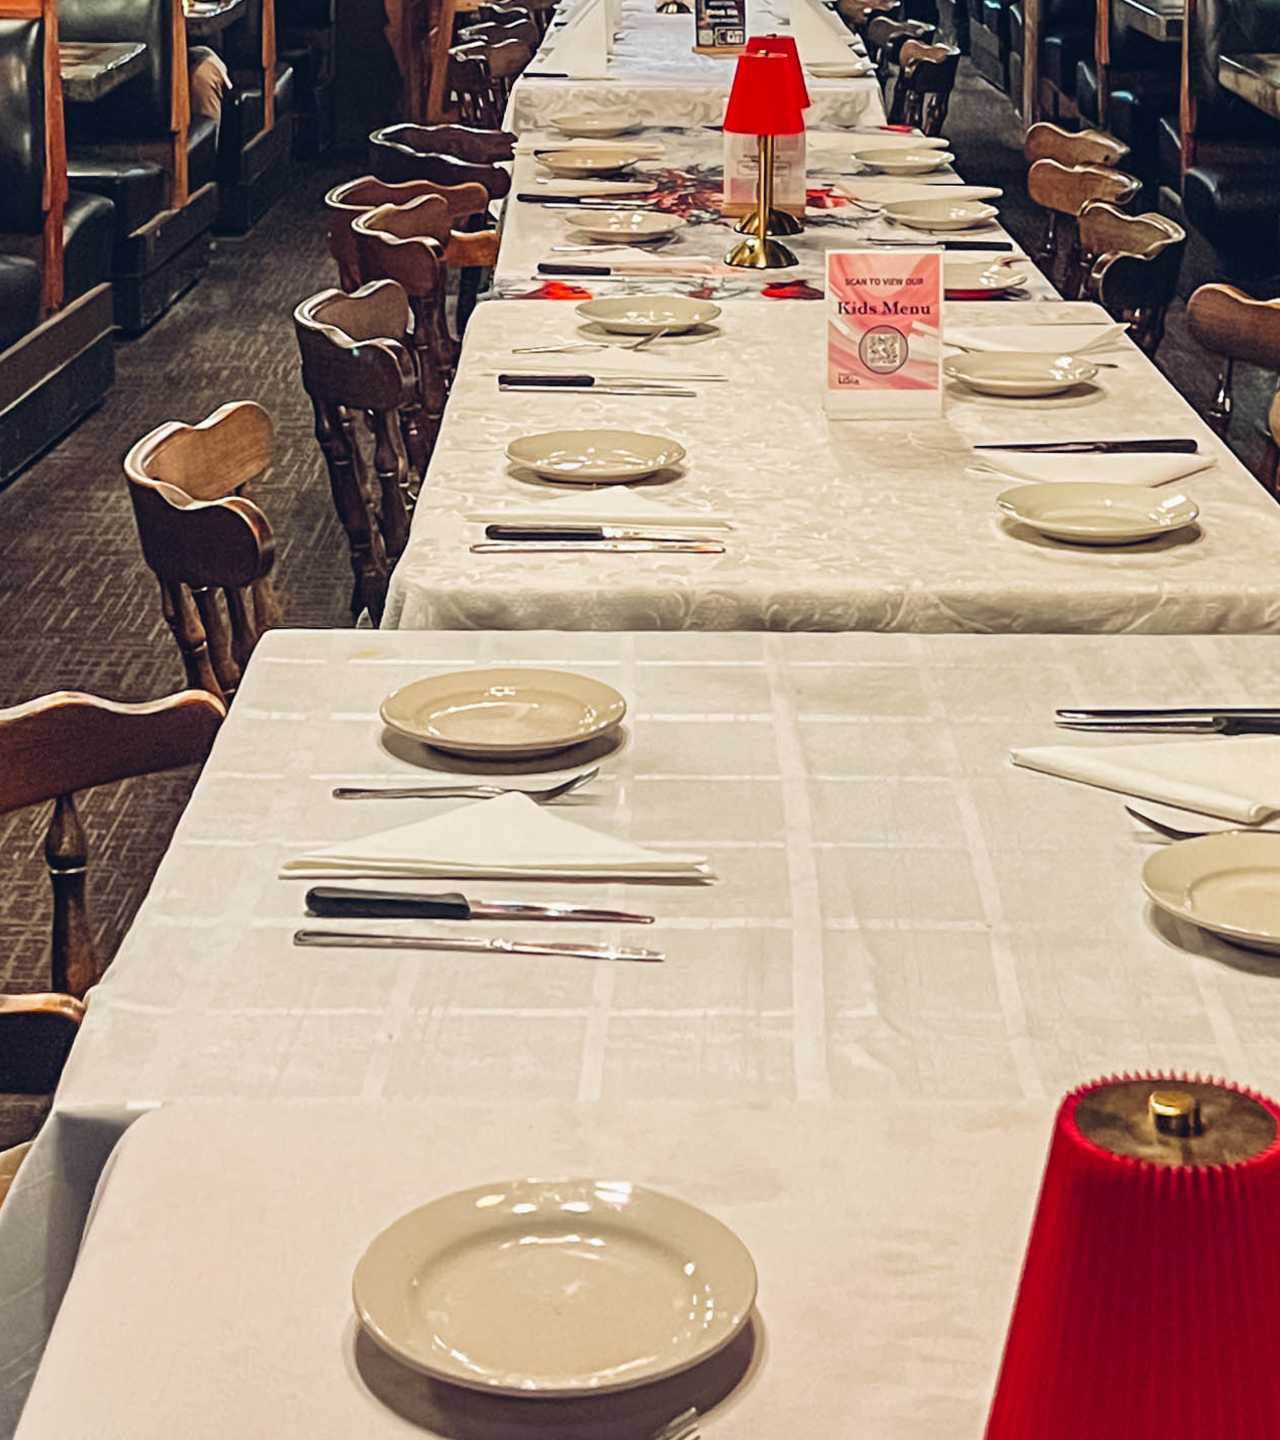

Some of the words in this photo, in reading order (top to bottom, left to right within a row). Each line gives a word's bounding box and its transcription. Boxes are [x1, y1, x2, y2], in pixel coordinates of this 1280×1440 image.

[845, 278, 867, 286] SCAN
[869, 278, 881, 286] TO
[883, 278, 903, 286] VIEW
[905, 278, 924, 286] OUR
[837, 301, 877, 315] Kids
[882, 301, 931, 315] Menu
